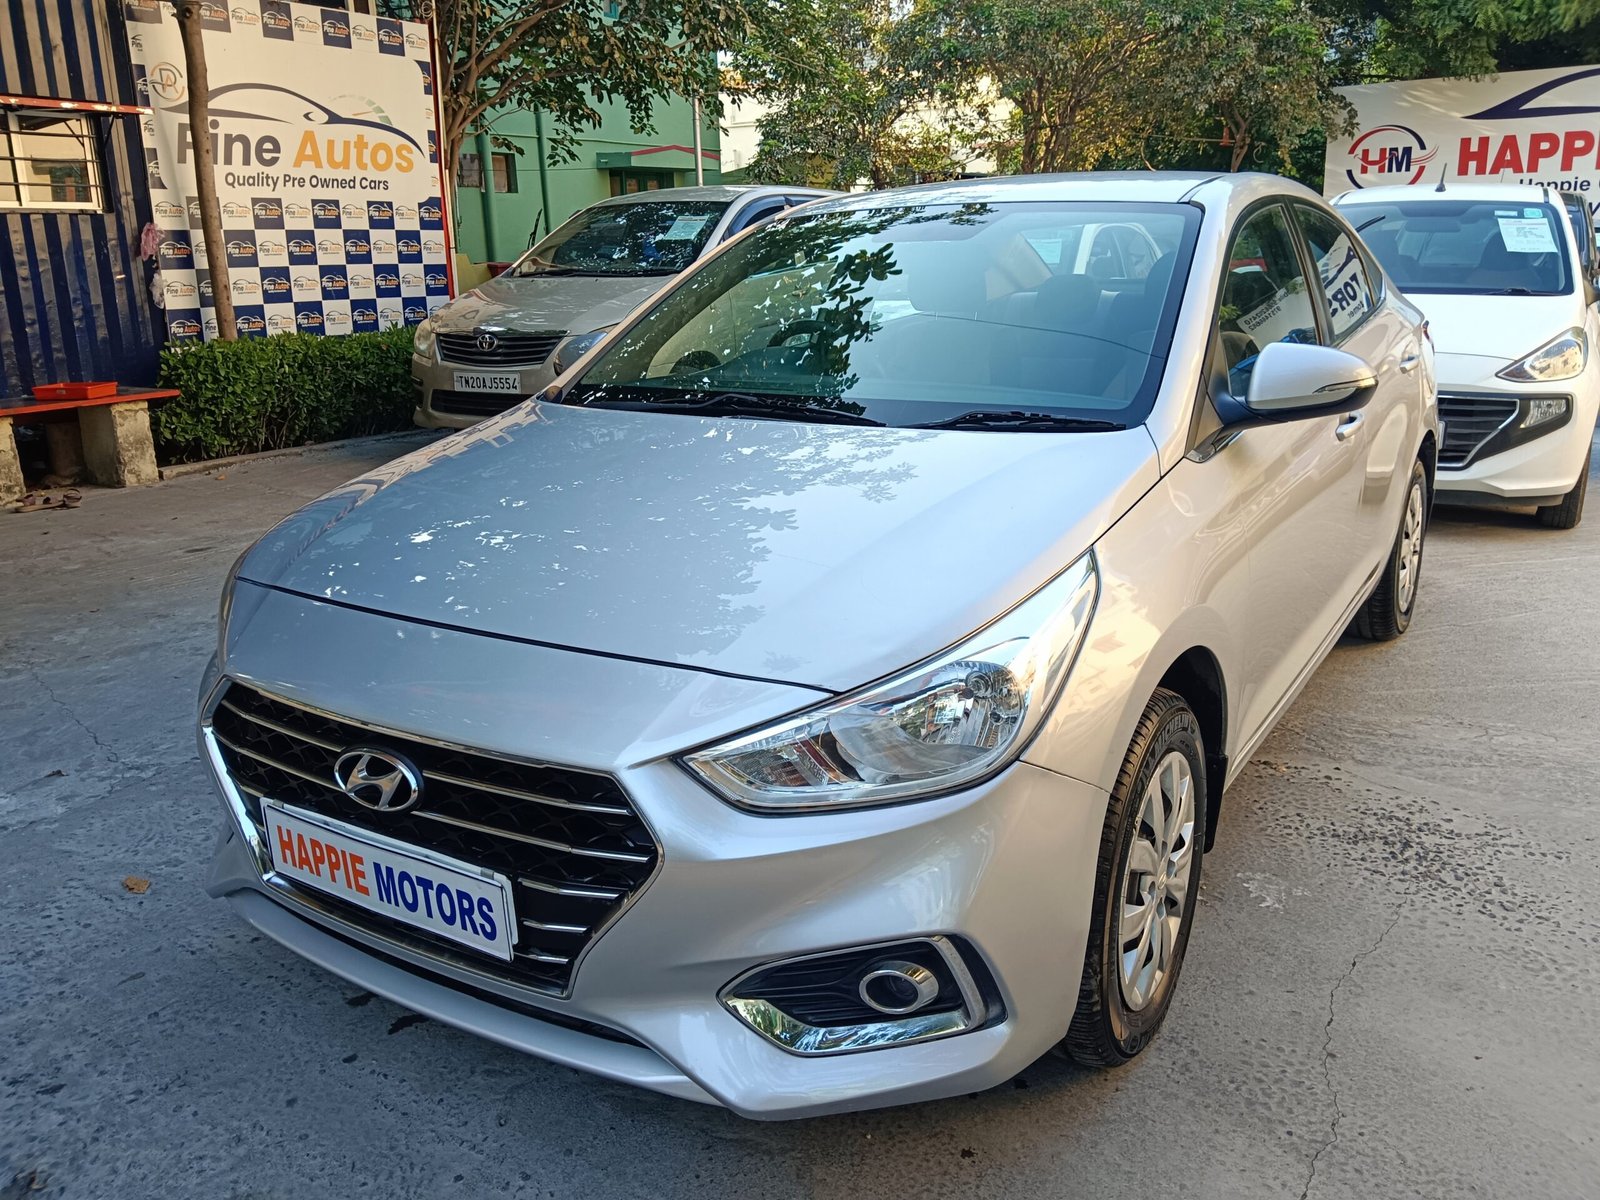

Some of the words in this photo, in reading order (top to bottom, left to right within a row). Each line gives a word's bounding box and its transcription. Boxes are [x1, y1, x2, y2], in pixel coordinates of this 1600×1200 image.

[292, 130, 414, 173] Autos
[1360, 146, 1412, 175] HM
[224, 171, 280, 192] Quality
[283, 174, 306, 188] Pre
[309, 174, 356, 190] Owned
[359, 176, 389, 191] Cars
[459, 376, 518, 390] TN20AJ5554
[276, 824, 370, 897] HAPPIE
[372, 861, 497, 942] MOTORS
